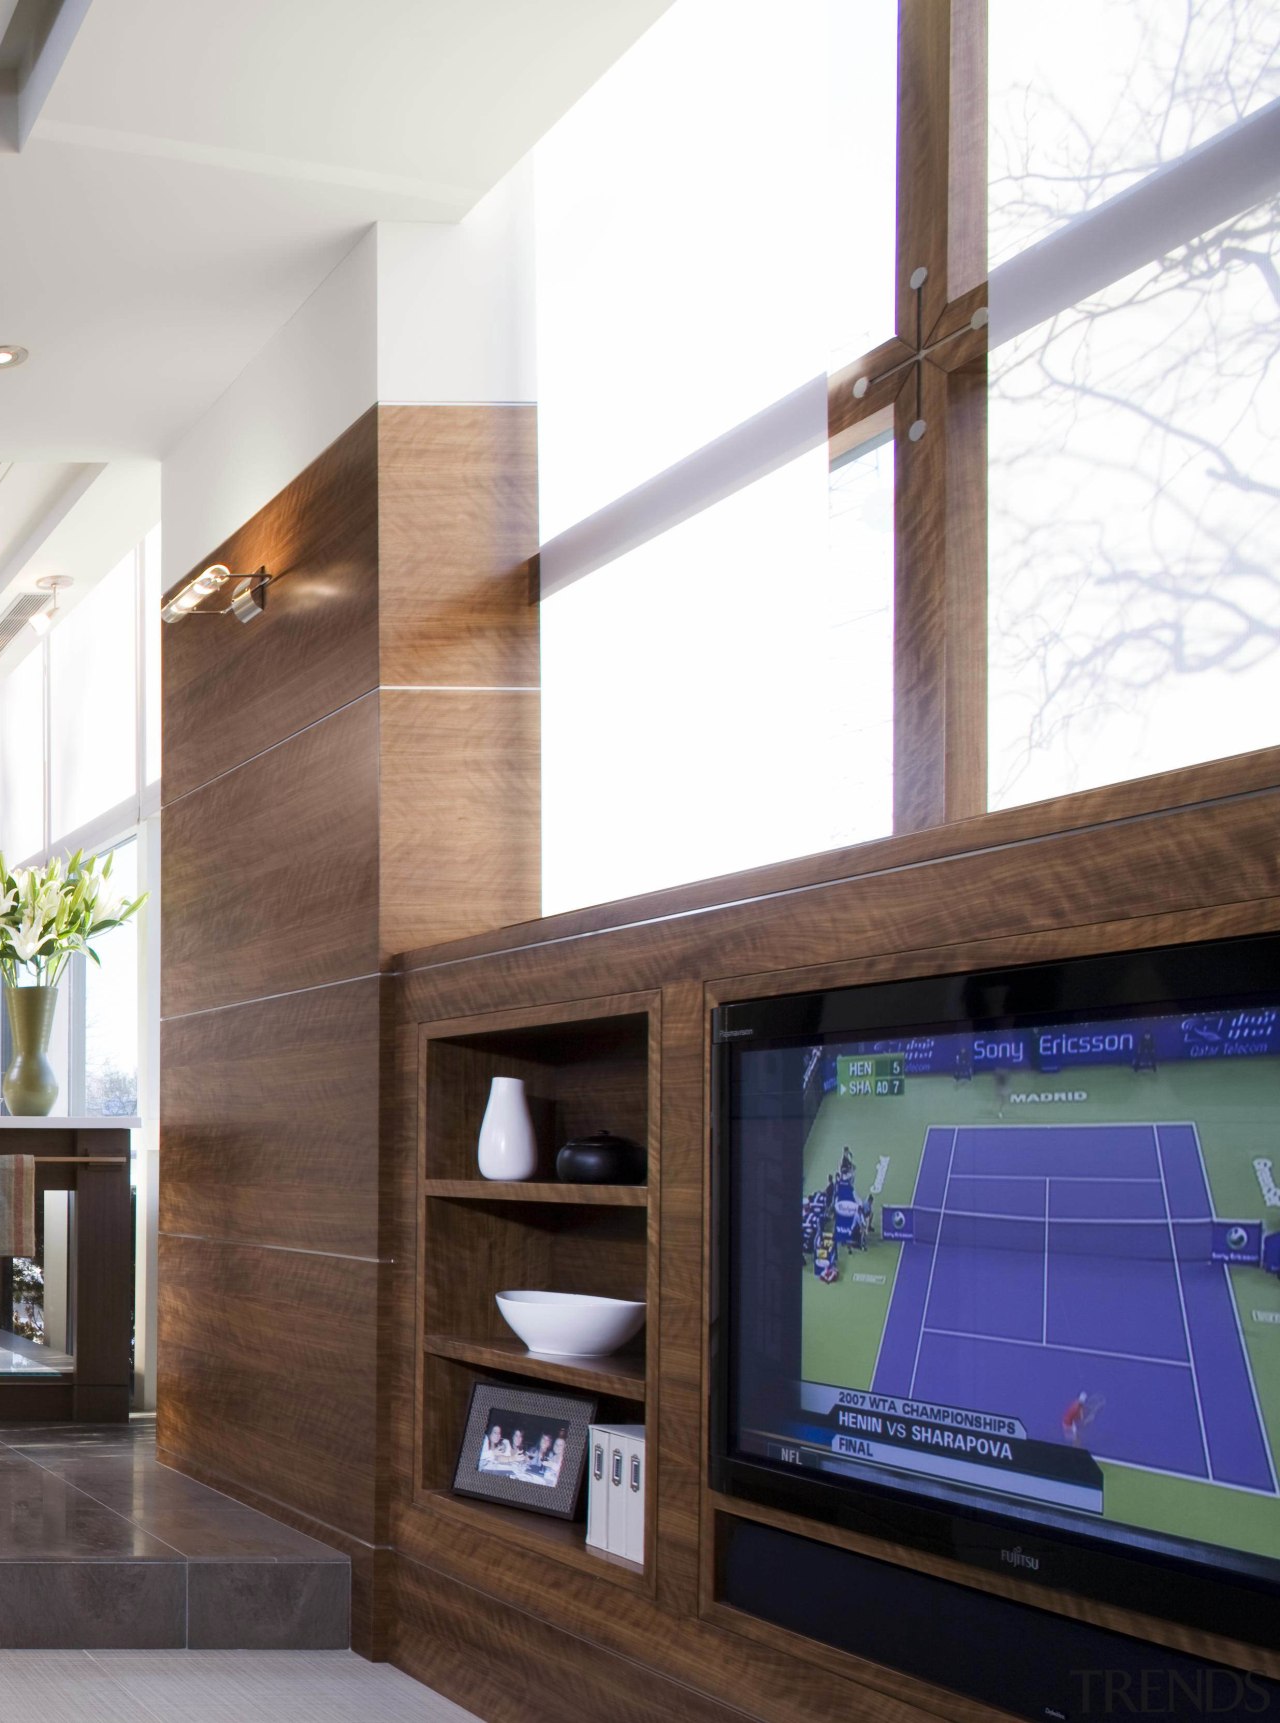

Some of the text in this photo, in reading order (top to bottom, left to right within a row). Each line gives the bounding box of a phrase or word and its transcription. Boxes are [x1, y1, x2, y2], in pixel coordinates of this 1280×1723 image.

[974, 1033, 1133, 1062] Sony Ericsson
[849, 1061, 900, 1077] HEN 5
[849, 1080, 872, 1095] SHA
[876, 1080, 889, 1095] AD
[893, 1080, 900, 1094] 7
[1010, 1091, 1088, 1103] MADRID
[838, 1390, 1017, 1436] 2007 WTA CHAMPIONSHIPS
[838, 1410, 1013, 1461] HENIN VS SHARAPOVA
[781, 1448, 803, 1466] NFL
[838, 1436, 874, 1458] FINAL
[1000, 1547, 1040, 1570] FUJITSU
